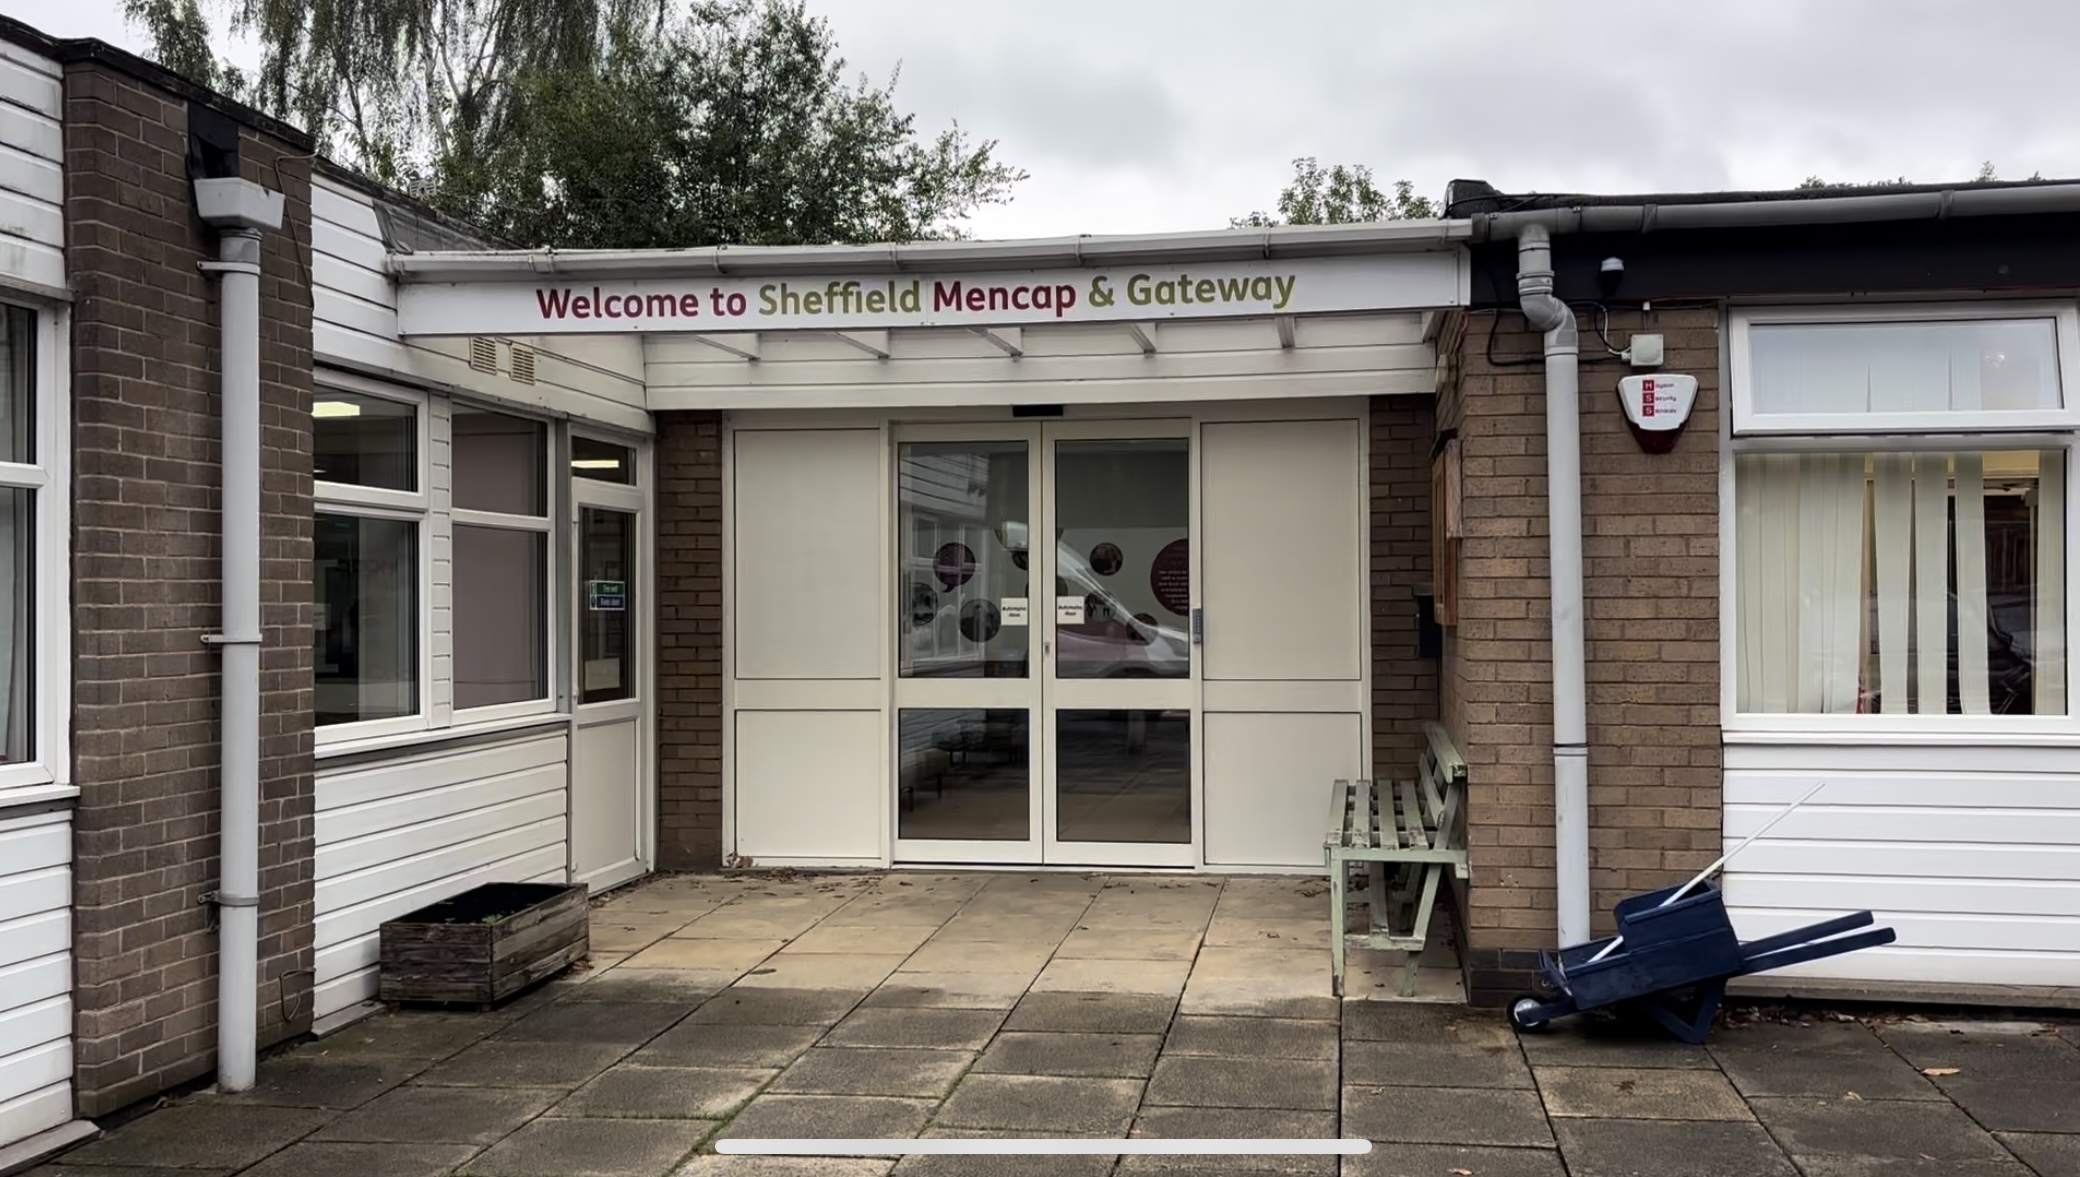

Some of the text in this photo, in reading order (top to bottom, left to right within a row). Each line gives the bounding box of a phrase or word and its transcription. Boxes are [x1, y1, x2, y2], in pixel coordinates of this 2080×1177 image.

[536, 273, 1296, 319] Welcome to Sheffield Mencap & Gateway
